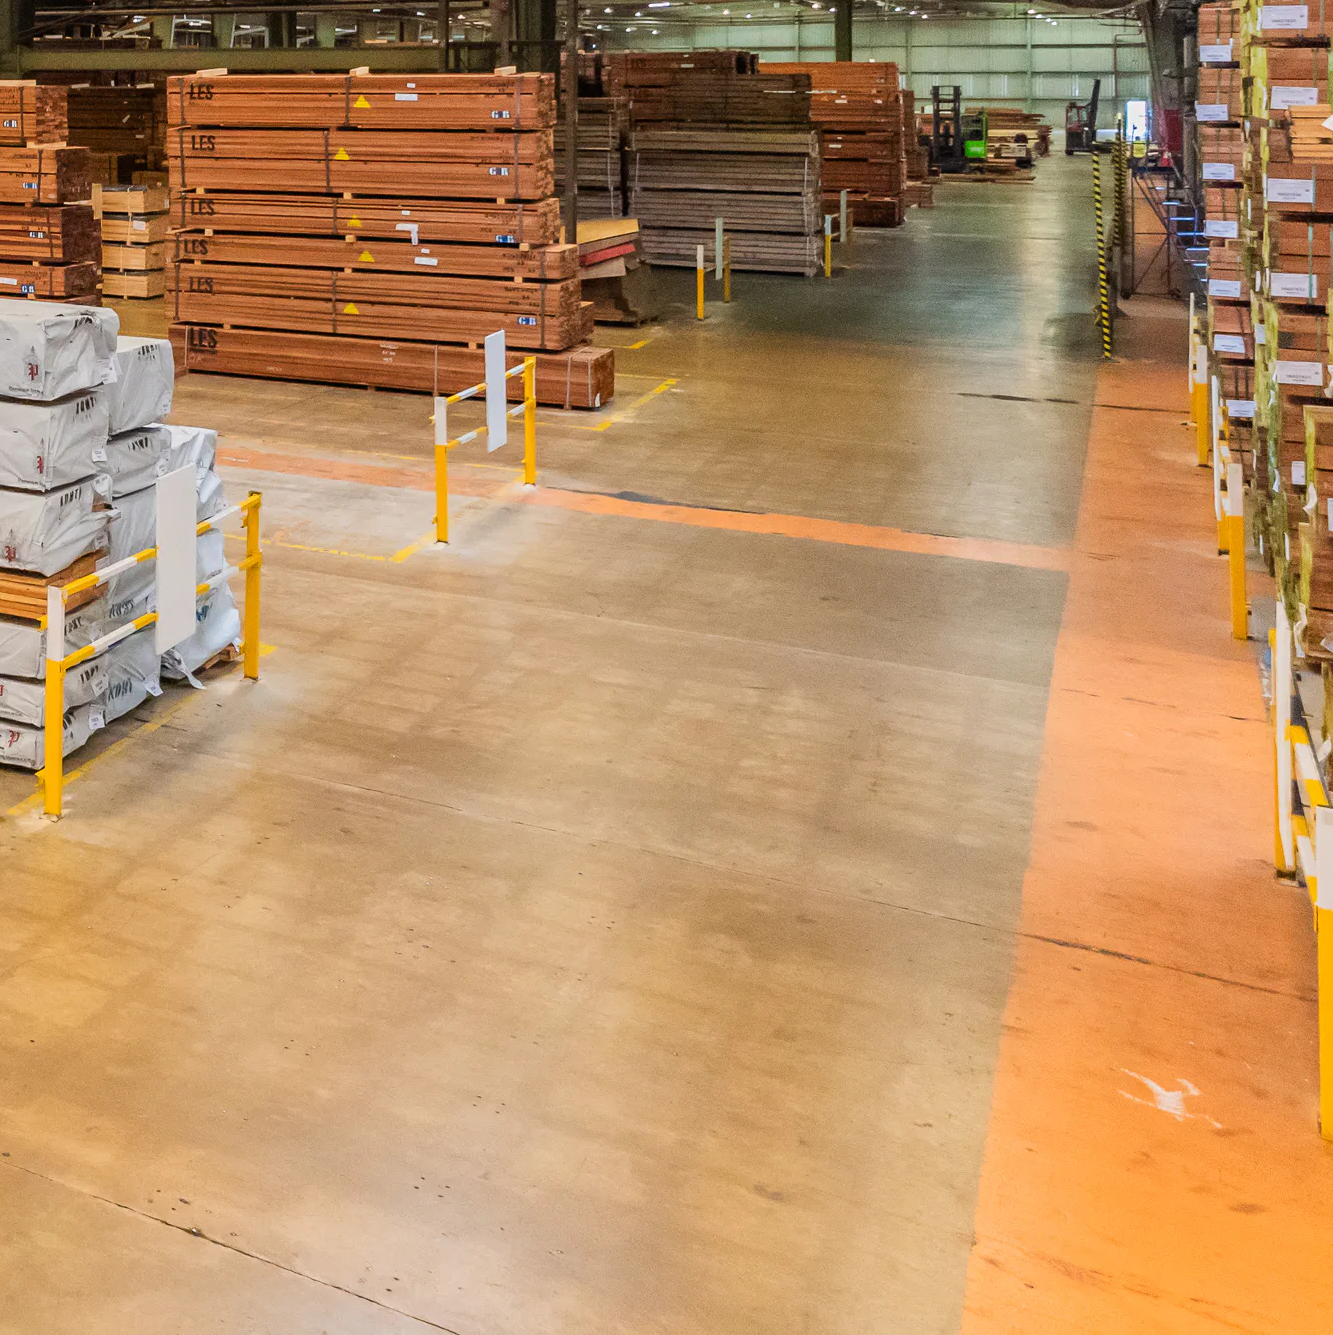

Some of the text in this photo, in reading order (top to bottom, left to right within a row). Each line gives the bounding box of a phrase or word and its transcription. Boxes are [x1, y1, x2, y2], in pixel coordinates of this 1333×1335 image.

[189, 83, 213, 100] LES
[191, 135, 215, 151] LES
[190, 199, 214, 216] LES
[183, 238, 208, 255] LES
[189, 276, 213, 292] LES
[189, 326, 218, 348] LES
